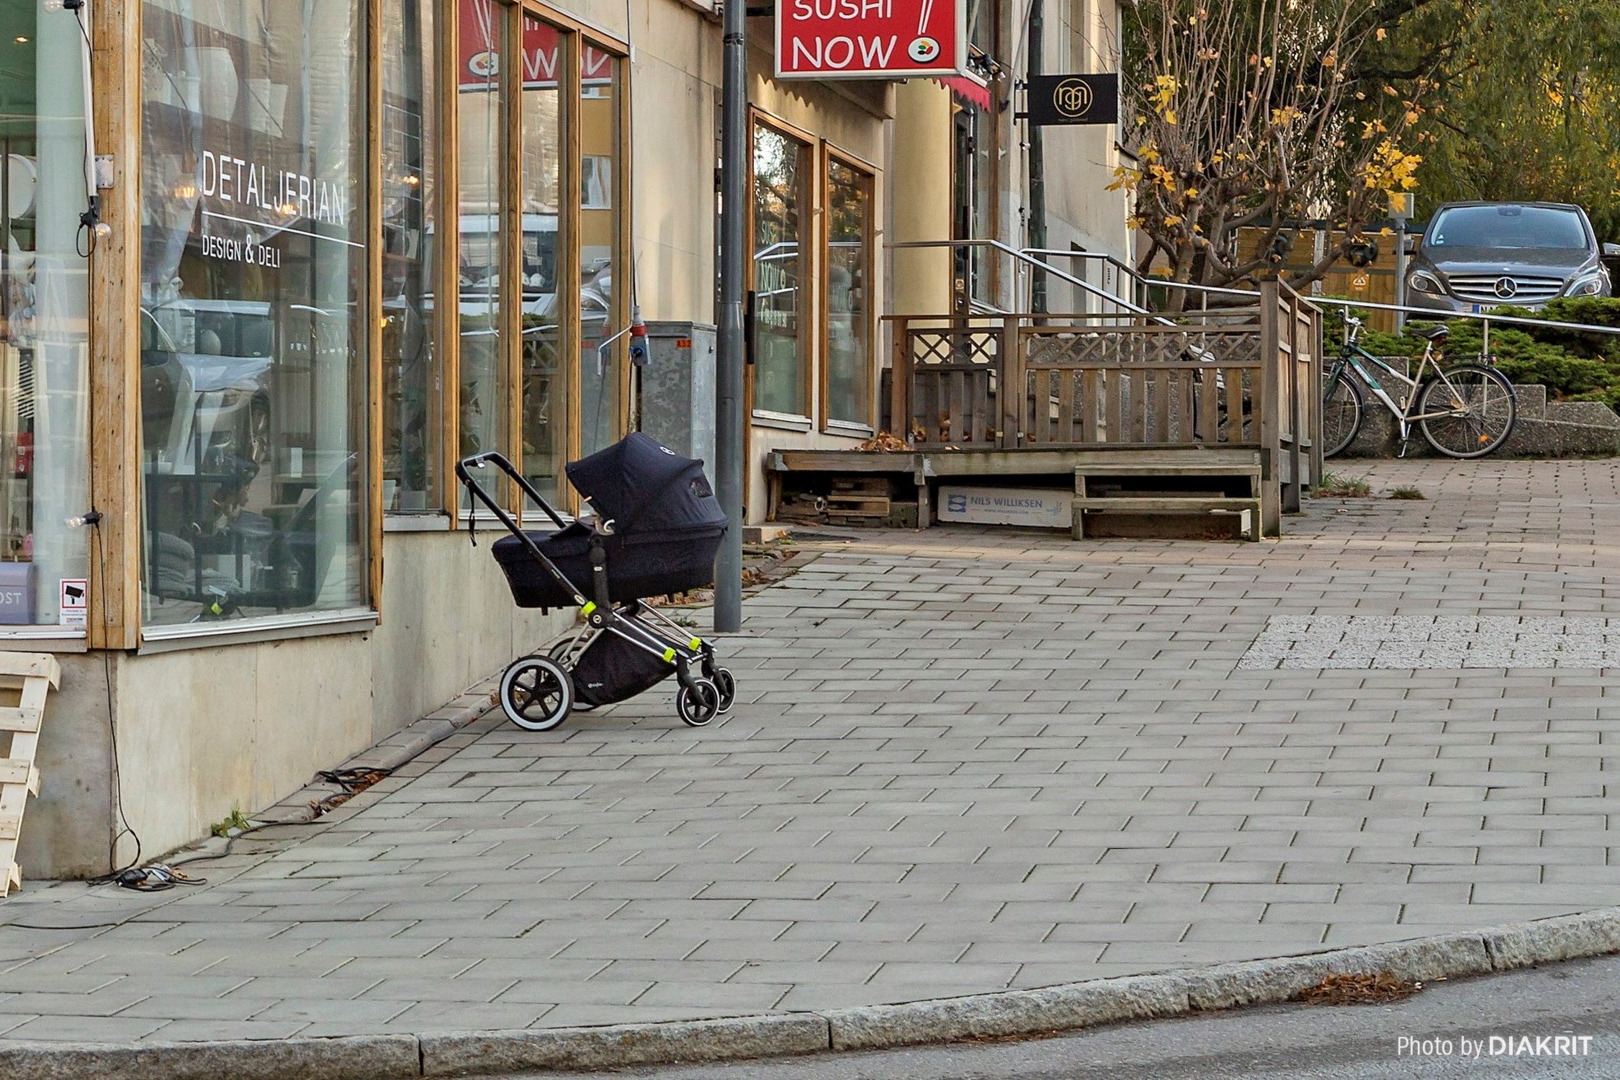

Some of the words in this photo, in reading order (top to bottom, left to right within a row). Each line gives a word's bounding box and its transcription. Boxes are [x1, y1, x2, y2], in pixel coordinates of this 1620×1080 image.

[792, 34, 898, 70] NOW
[203, 150, 344, 226] DETALJERIAN
[202, 234, 241, 262] DESIGN
[245, 234, 255, 264] &
[258, 245, 280, 269] DELI
[971, 497, 991, 506] NILS
